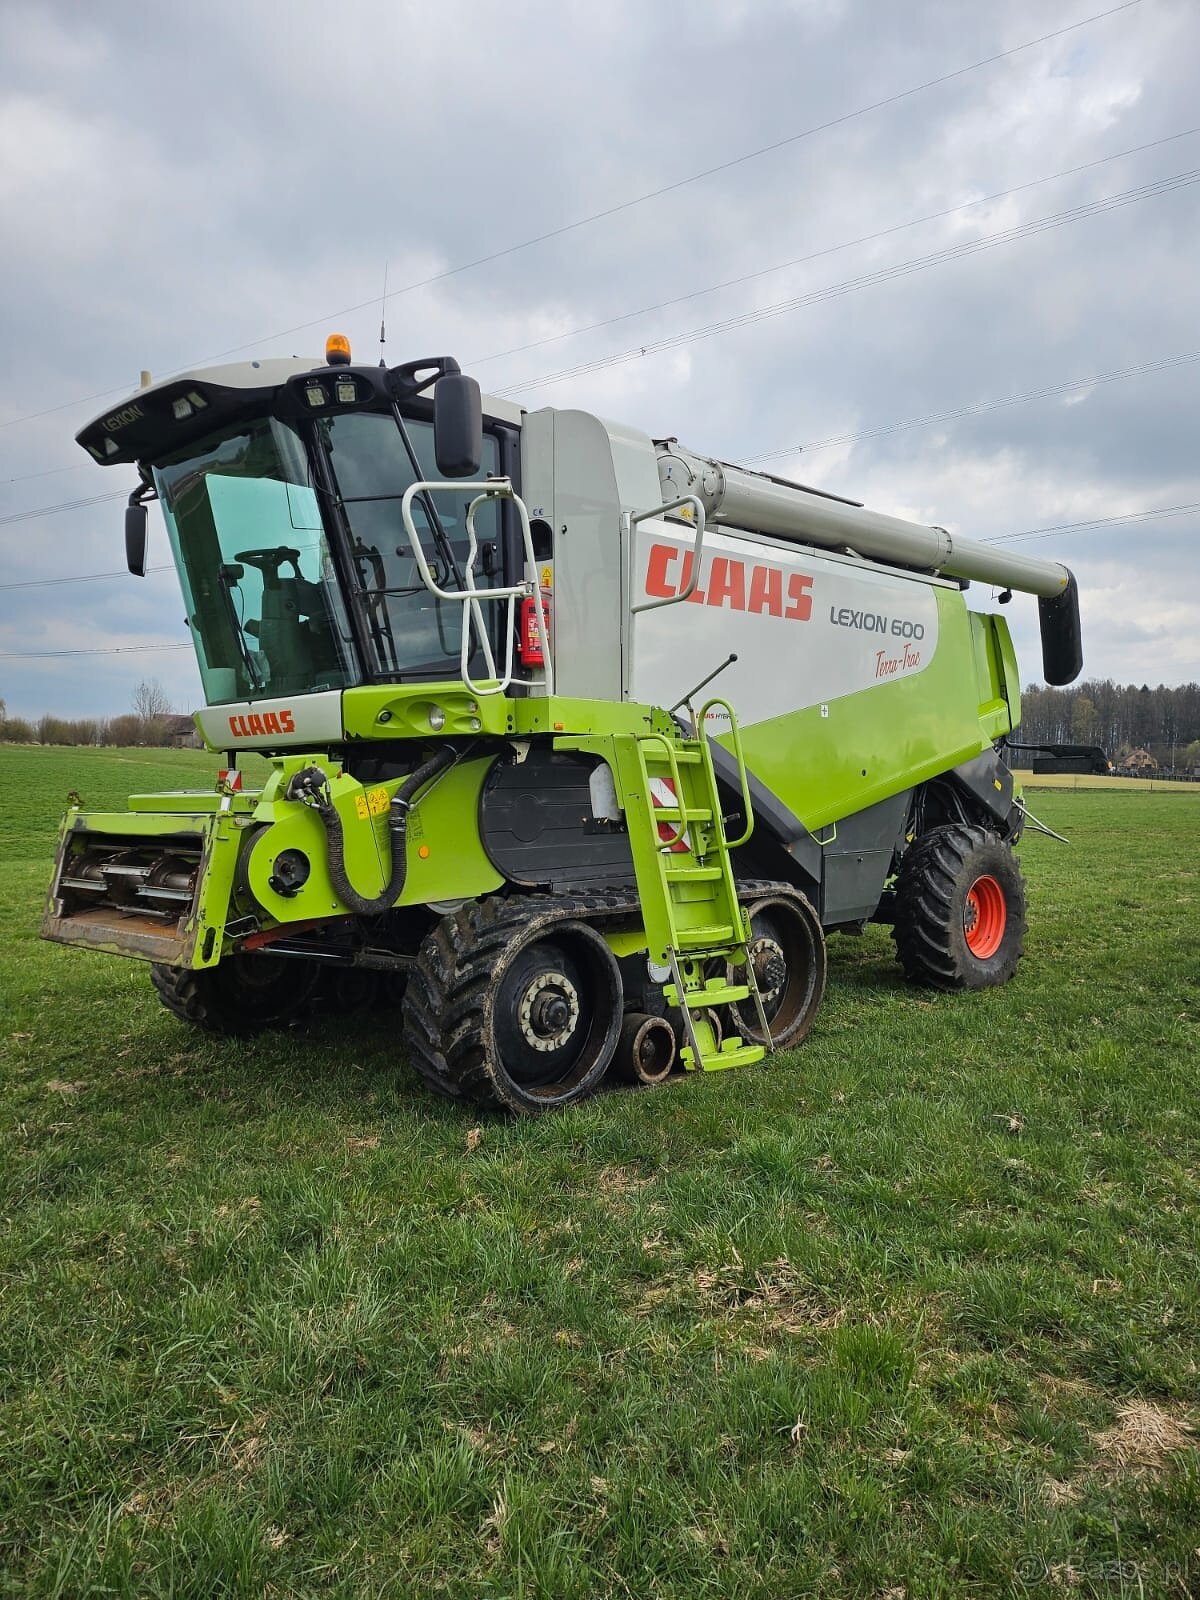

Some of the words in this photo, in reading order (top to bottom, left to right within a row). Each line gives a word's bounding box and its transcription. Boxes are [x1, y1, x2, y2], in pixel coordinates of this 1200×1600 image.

[102, 405, 144, 432] LEXION
[645, 543, 814, 622] CLAAS
[830, 606, 888, 634] LEXION
[891, 619, 925, 641] 600
[875, 642, 921, 679] Terra-Trac
[228, 710, 296, 737] CLAAS
